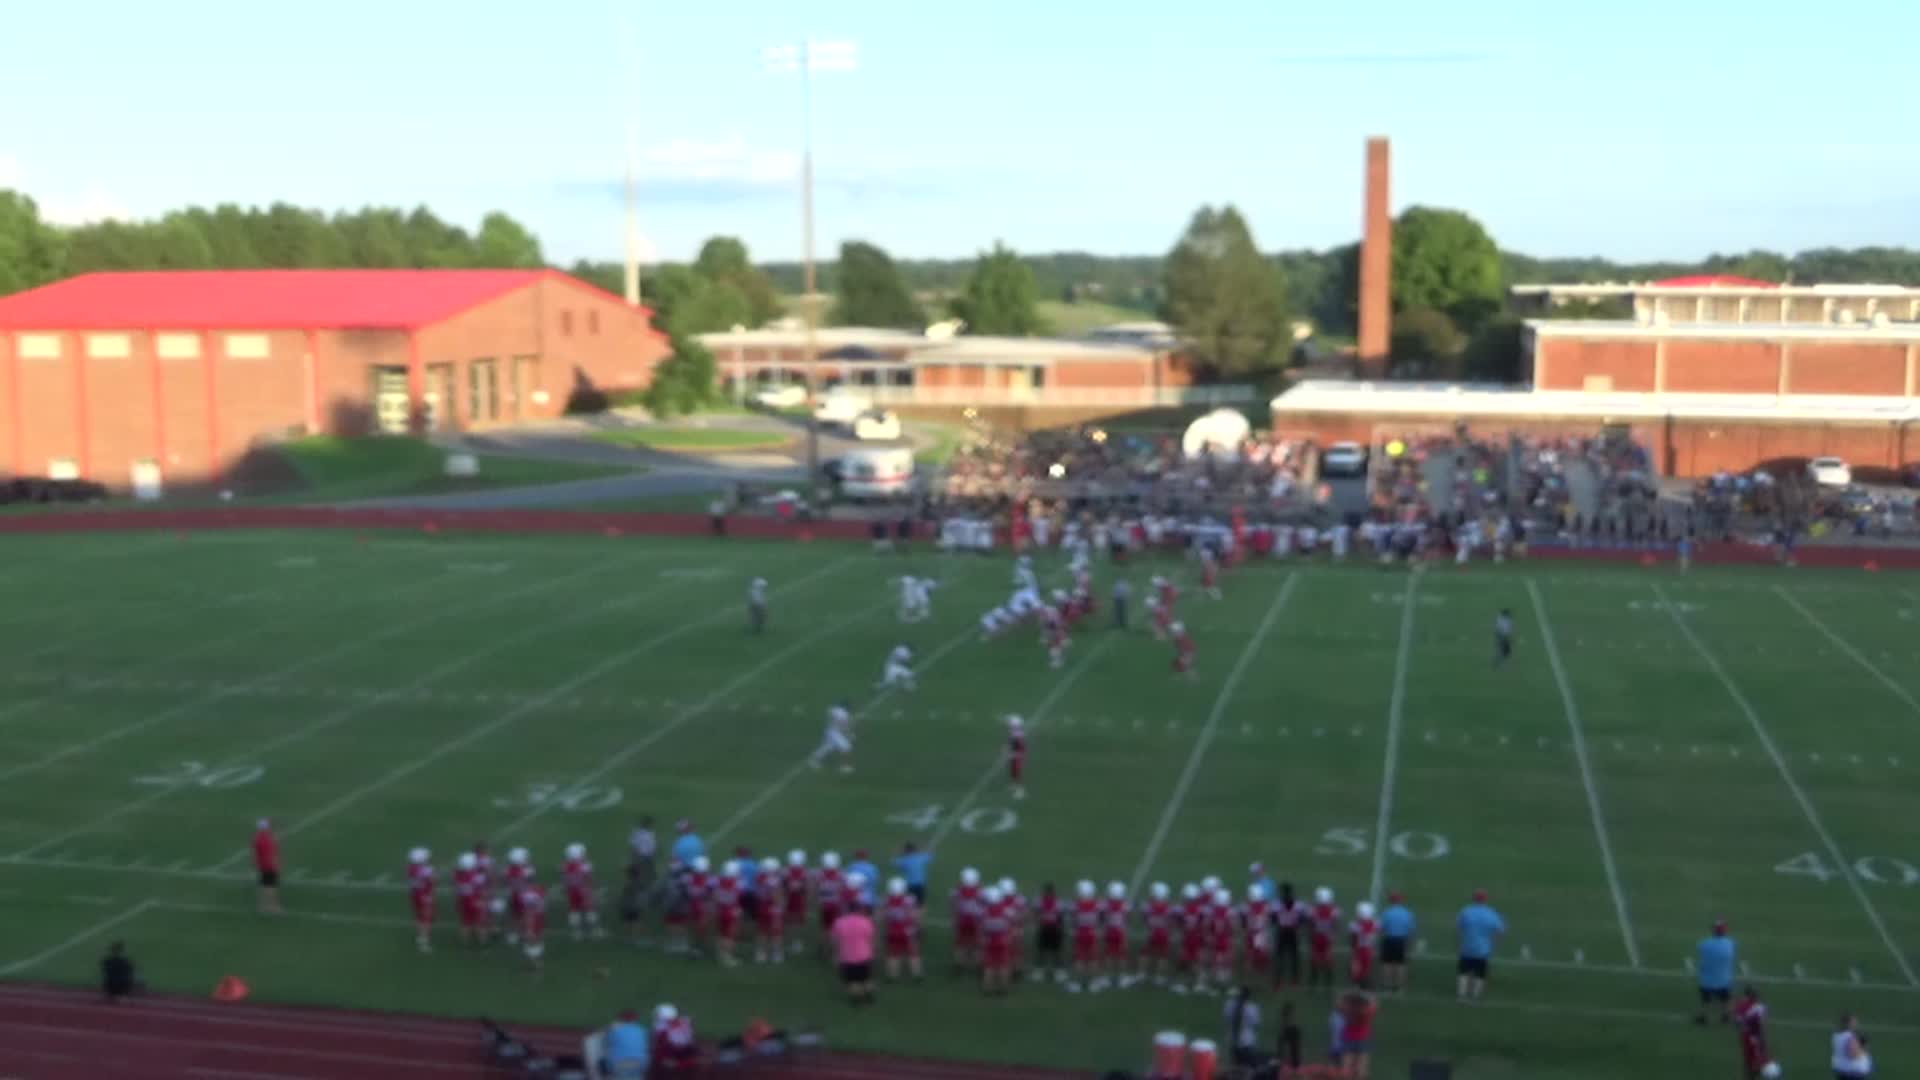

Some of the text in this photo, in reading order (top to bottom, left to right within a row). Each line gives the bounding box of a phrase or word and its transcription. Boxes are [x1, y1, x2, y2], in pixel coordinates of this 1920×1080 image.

[885, 804, 1019, 833] 40
[1313, 827, 1450, 860] 50
[1773, 851, 1919, 885] 40
